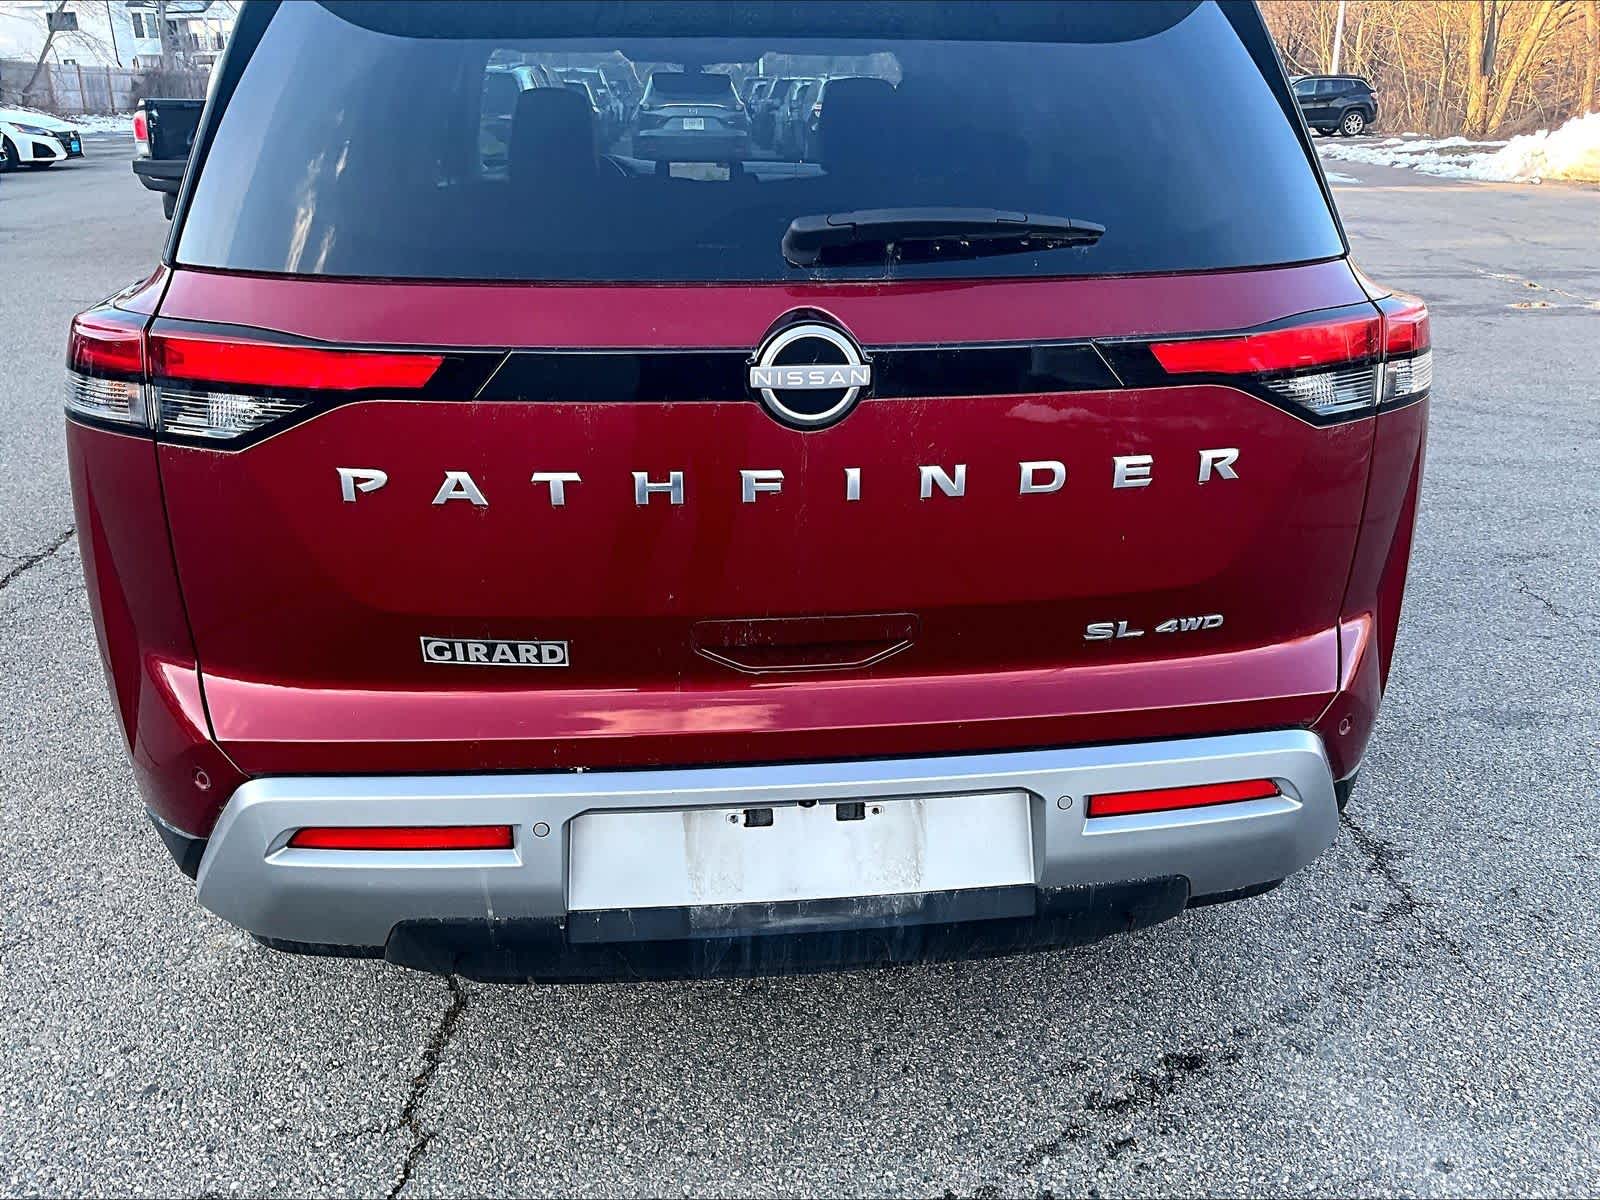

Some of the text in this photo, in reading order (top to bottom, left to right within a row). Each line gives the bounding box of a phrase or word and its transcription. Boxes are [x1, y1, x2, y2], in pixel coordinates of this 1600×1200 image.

[754, 368, 867, 386] NISSAN
[336, 447, 1240, 505] PATHFINDER
[1083, 614, 1224, 641] SL 4WD
[426, 641, 564, 664] GIRARD
